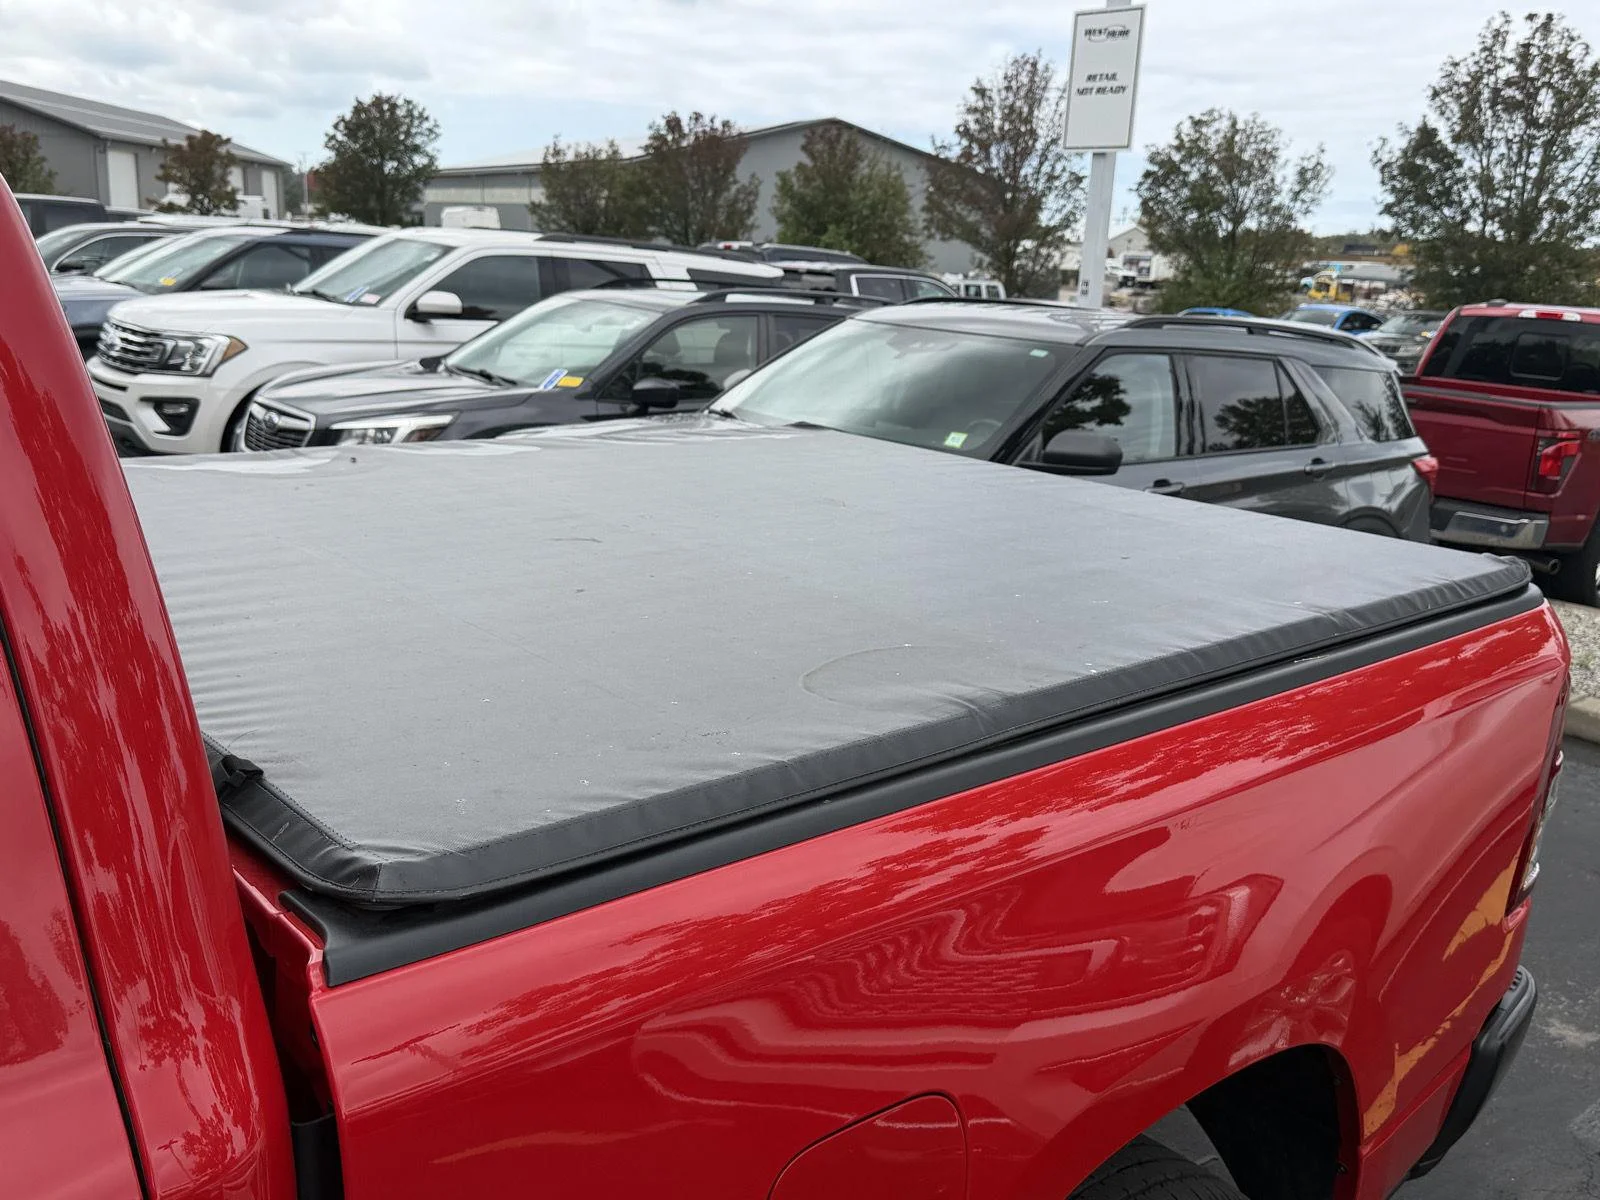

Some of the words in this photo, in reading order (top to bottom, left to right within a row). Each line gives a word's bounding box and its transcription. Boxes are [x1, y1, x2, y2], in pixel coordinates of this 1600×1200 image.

[1086, 72, 1118, 82] RETAIL
[1077, 87, 1094, 96] NOT
[1095, 85, 1127, 95] READY
